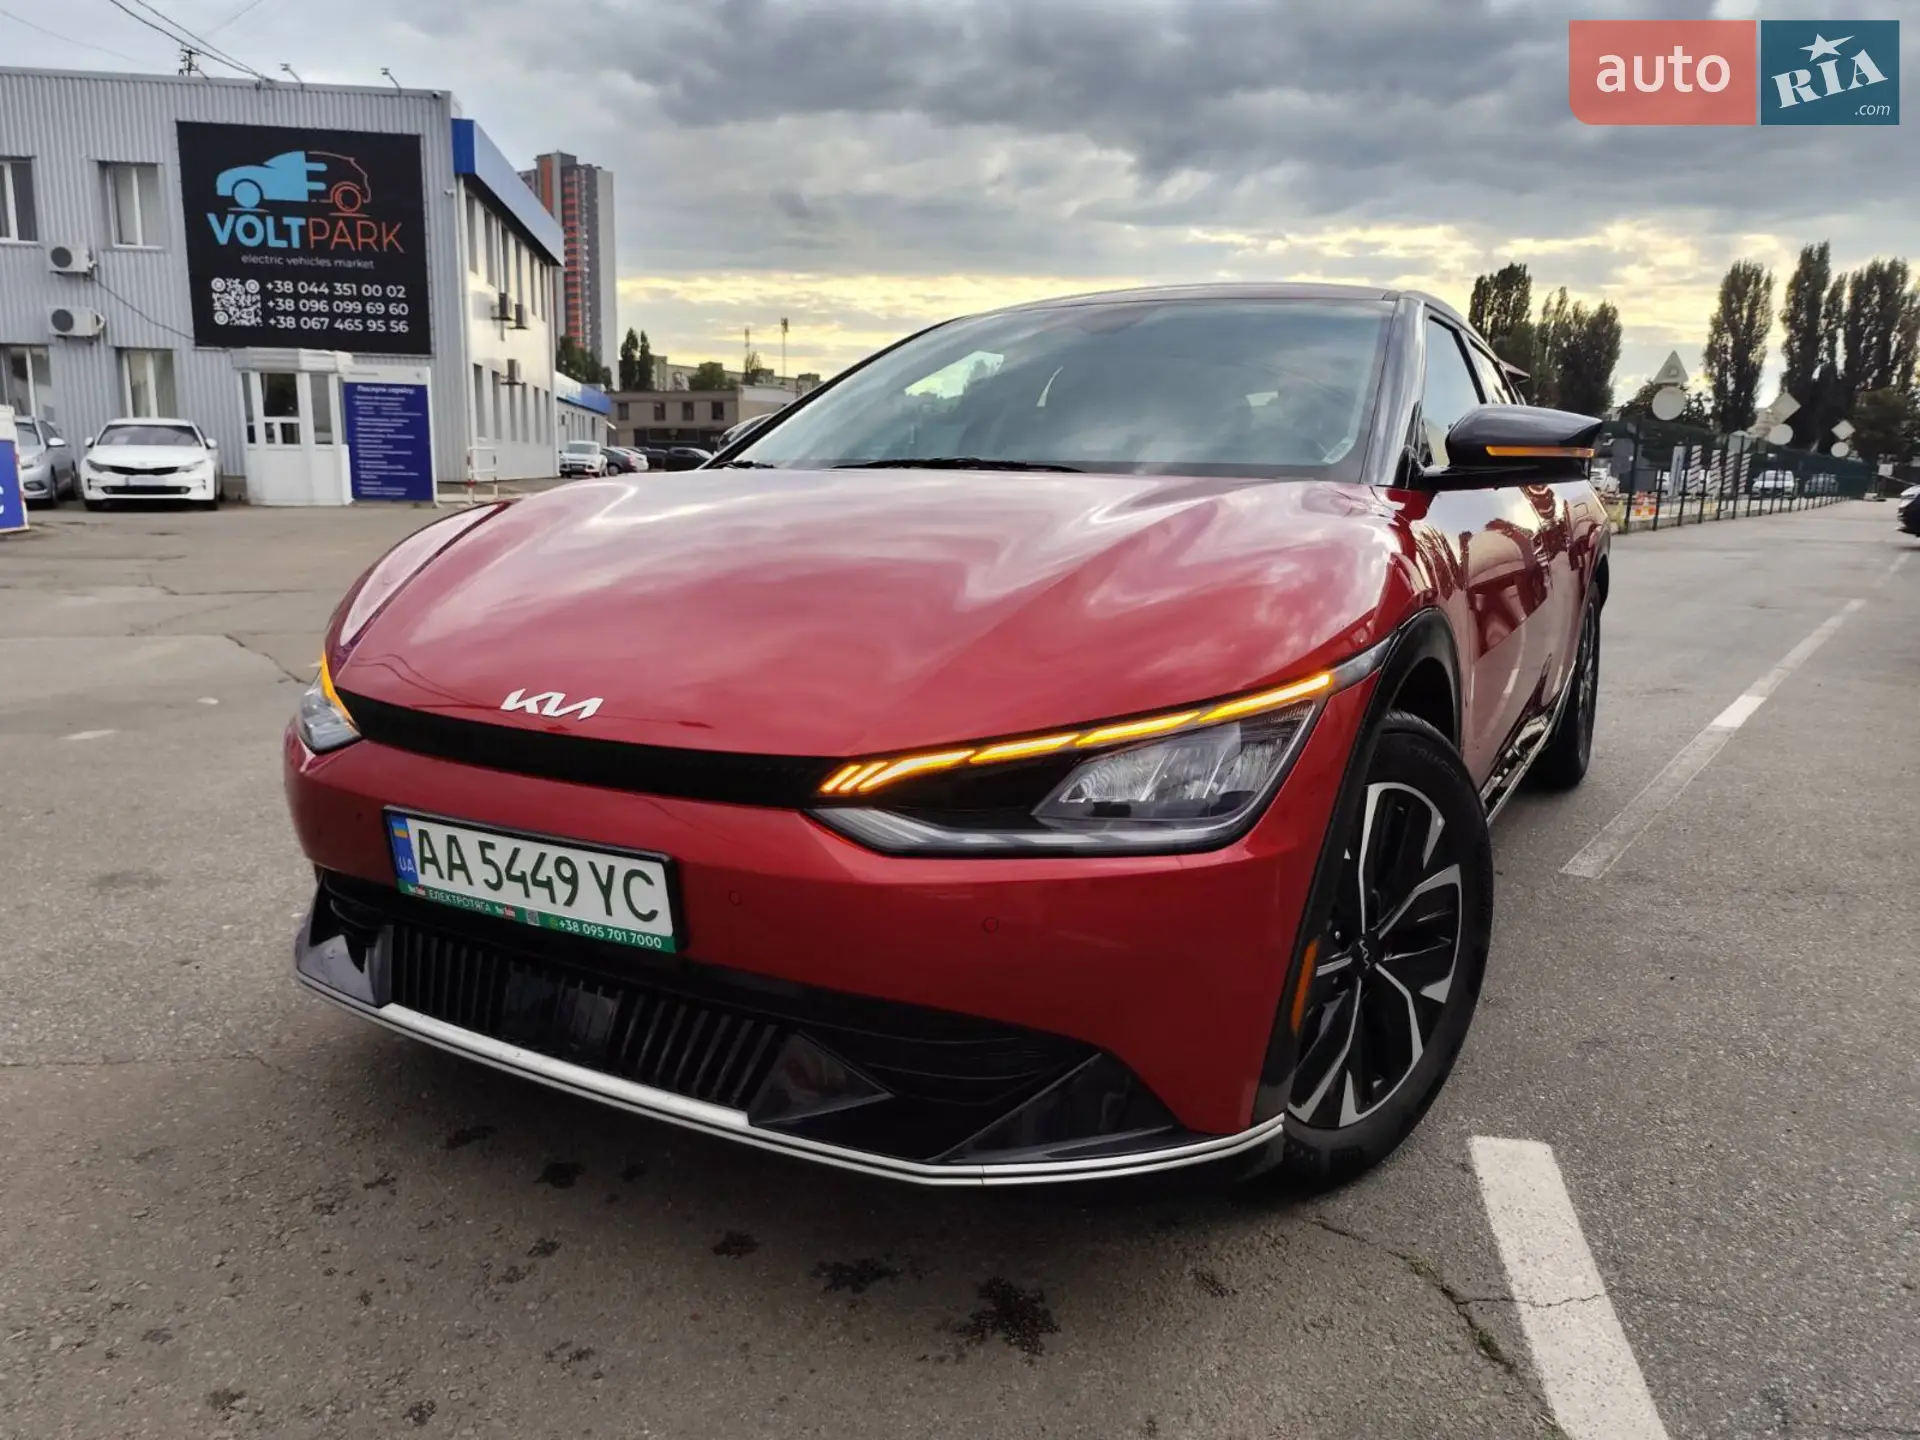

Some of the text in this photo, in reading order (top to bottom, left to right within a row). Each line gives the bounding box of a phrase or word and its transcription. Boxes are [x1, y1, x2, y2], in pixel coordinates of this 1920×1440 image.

[241, 254, 375, 270] electric vehicles market
[266, 280, 406, 298] +38 044 351 00 02
[267, 298, 409, 316] +38 096 099 69 60
[268, 316, 409, 333] +38 067 465 95 56
[399, 855, 415, 873] UA
[559, 919, 662, 949] +38 095 701 7000
